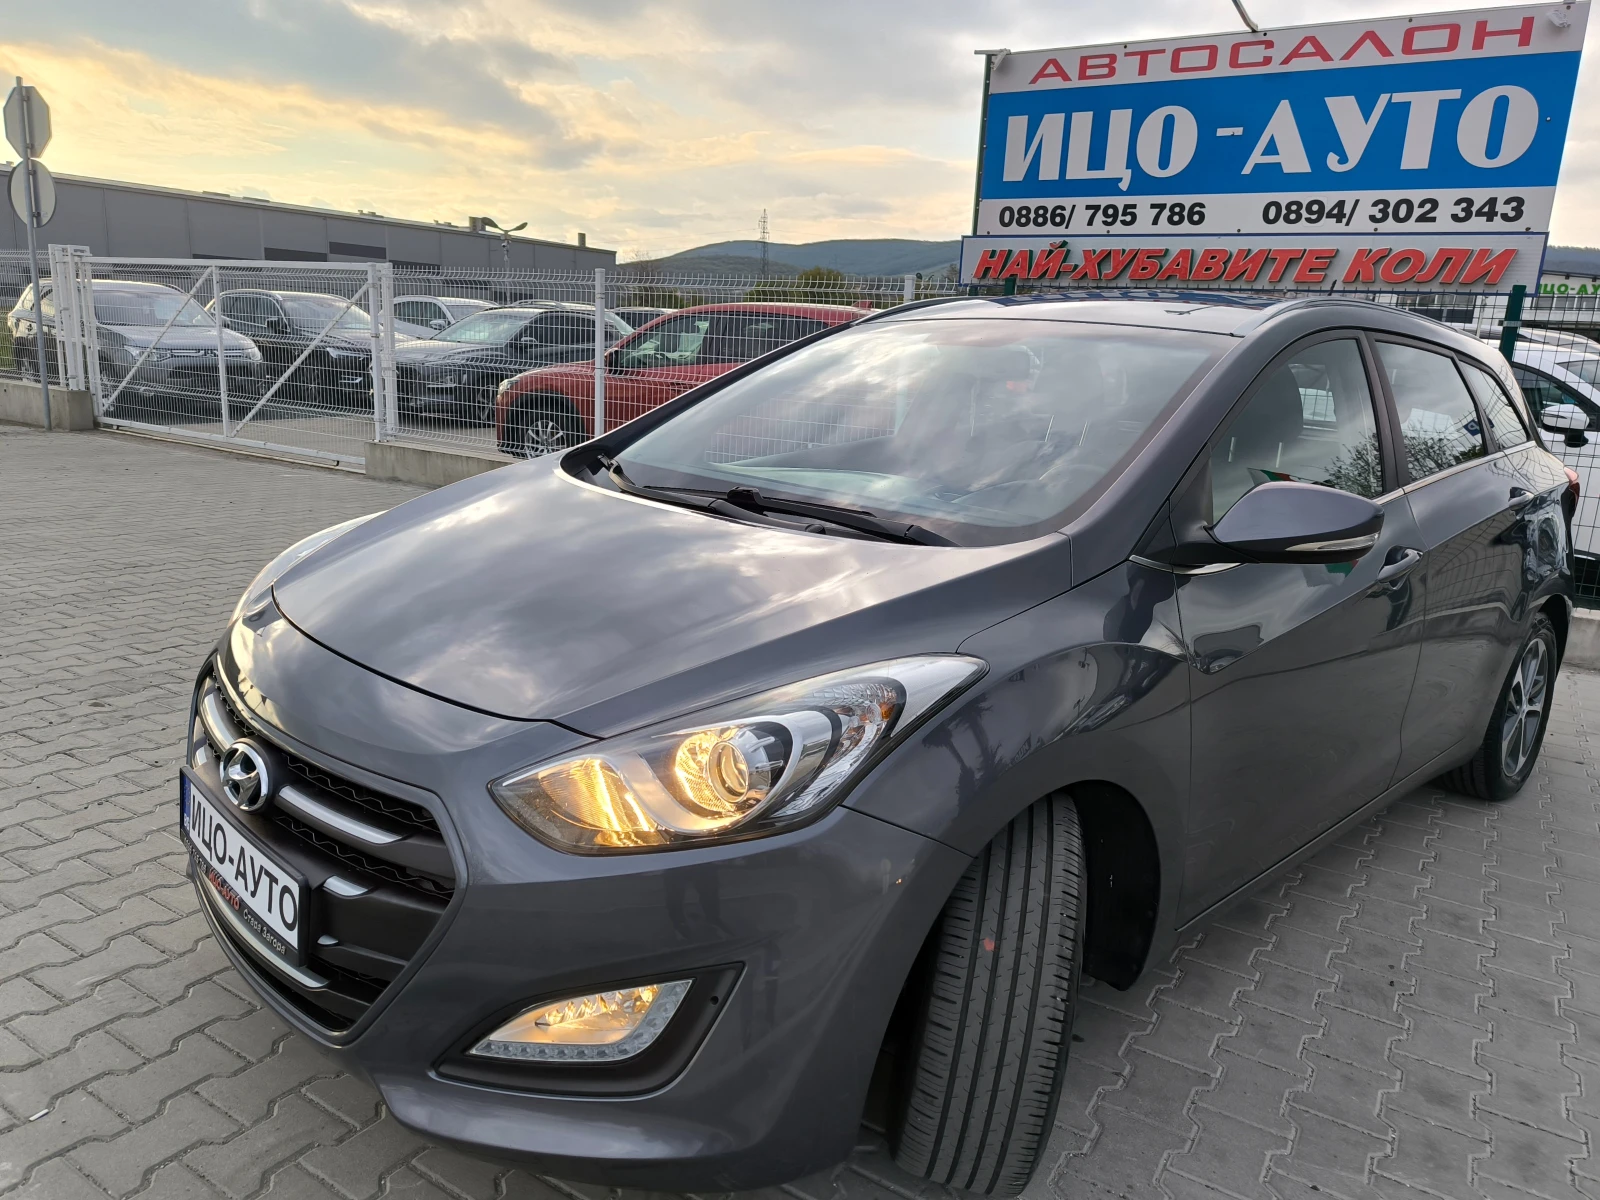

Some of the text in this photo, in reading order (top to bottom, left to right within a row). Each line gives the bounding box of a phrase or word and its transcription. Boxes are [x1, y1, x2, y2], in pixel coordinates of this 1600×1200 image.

[1028, 16, 1535, 85] АВТОСАЛОН
[998, 196, 1526, 230] 0886/ 795 786 0894/ 302 343
[971, 240, 1518, 286] НАЙ-ХУБАВИТЕ КОЛИ
[191, 794, 298, 932] ИЦО-АУТО
[243, 908, 261, 933] Стара
[262, 926, 286, 955] Загора
